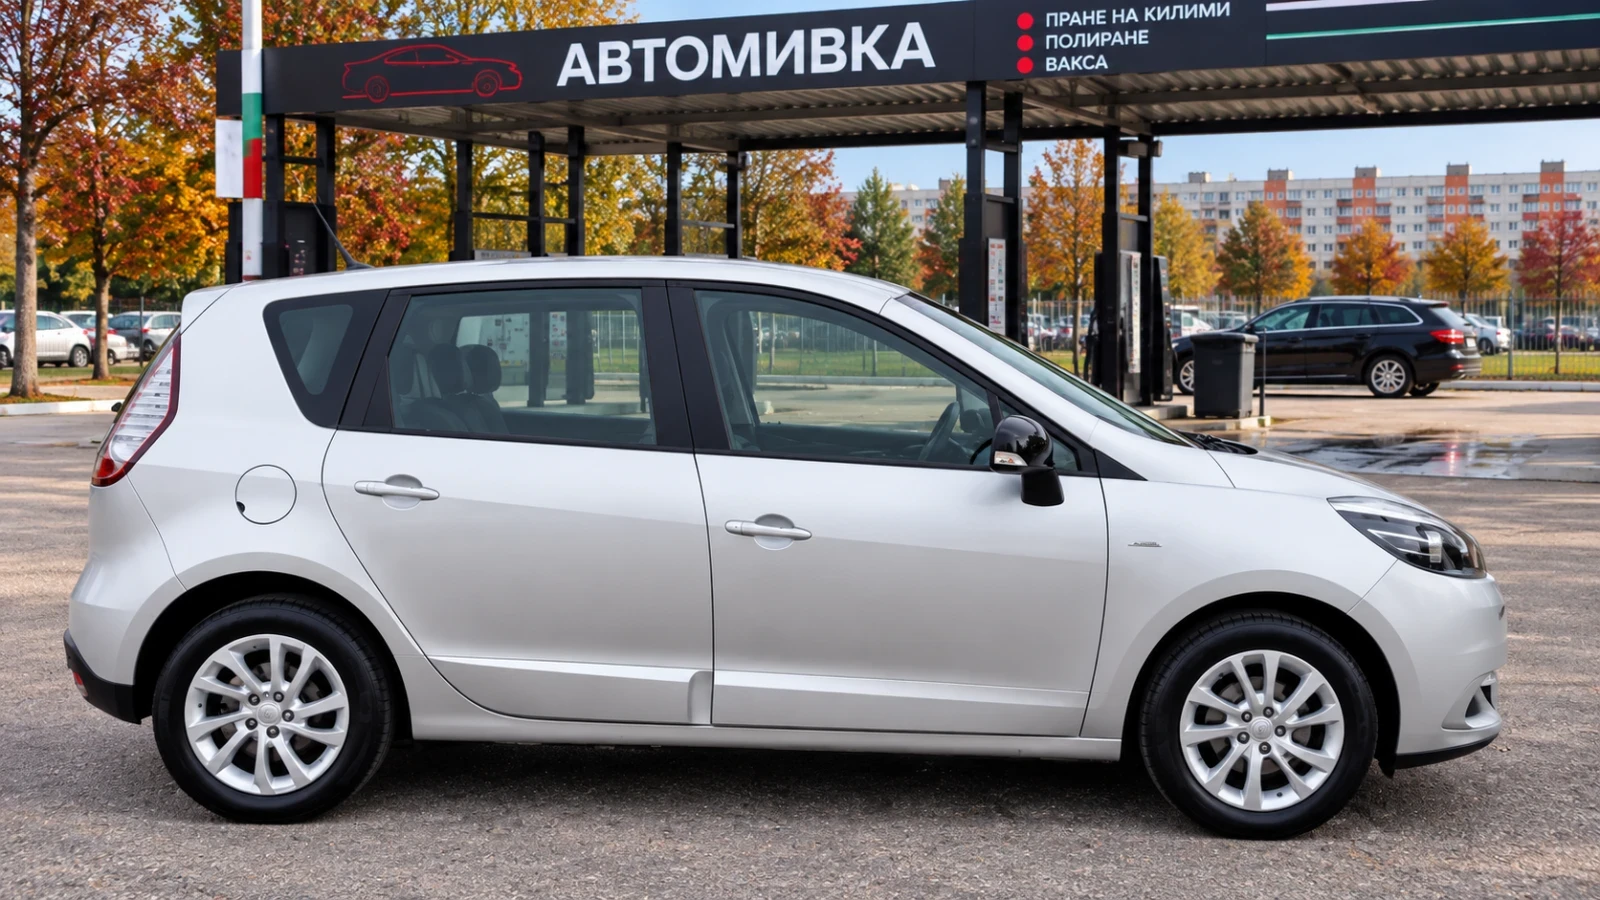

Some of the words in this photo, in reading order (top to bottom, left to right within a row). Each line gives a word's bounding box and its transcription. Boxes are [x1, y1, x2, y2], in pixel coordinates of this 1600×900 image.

[1045, 9, 1107, 28] ПРАНЕ
[1111, 7, 1139, 24] НА
[1144, 2, 1231, 21] КИЛИМИ
[1045, 29, 1149, 50] ПОЛИРАНЕ
[556, 22, 936, 87] АВТОМИВКА
[1045, 54, 1108, 72] ВАКСА
